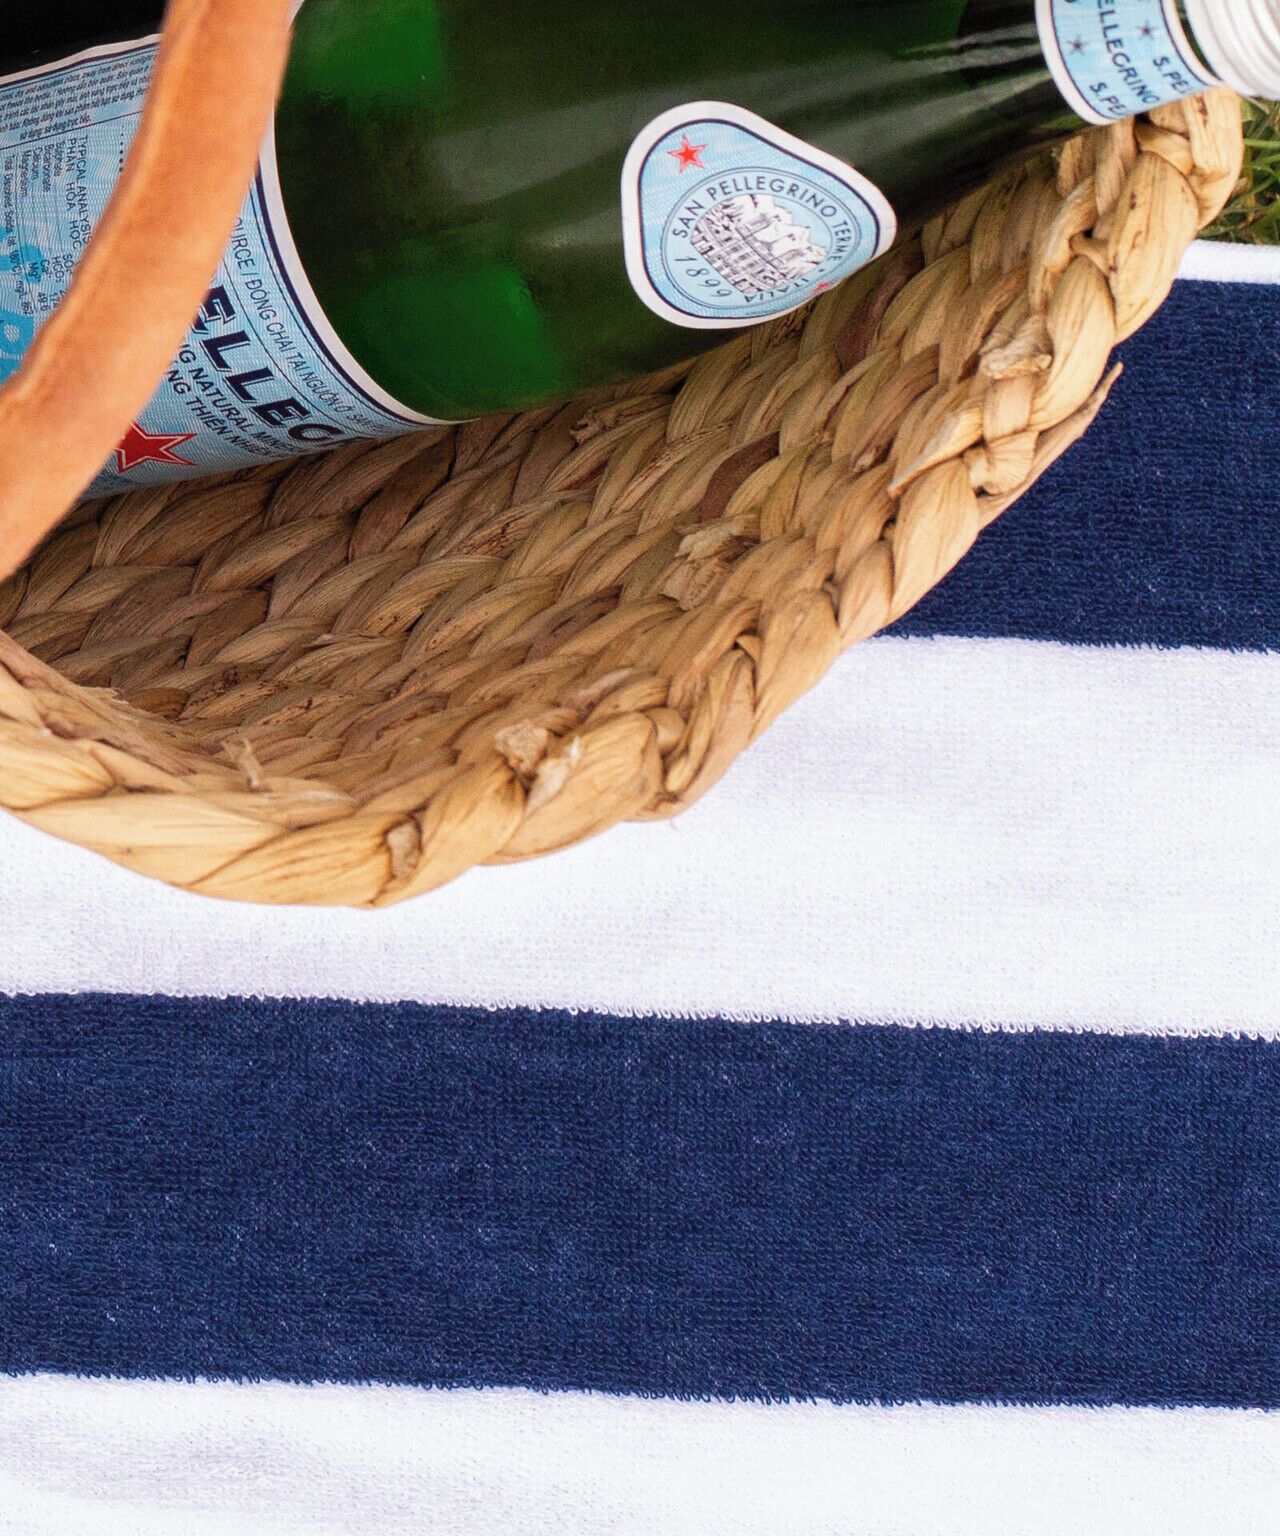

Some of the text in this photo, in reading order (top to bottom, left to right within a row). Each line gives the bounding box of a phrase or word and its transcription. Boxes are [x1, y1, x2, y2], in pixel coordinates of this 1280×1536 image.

[76, 136, 92, 244] TYPICAL ANALYSIS
[672, 199, 706, 238] SAN
[707, 176, 837, 219] PELLEGRINO
[191, 366, 249, 432] NATURAL
